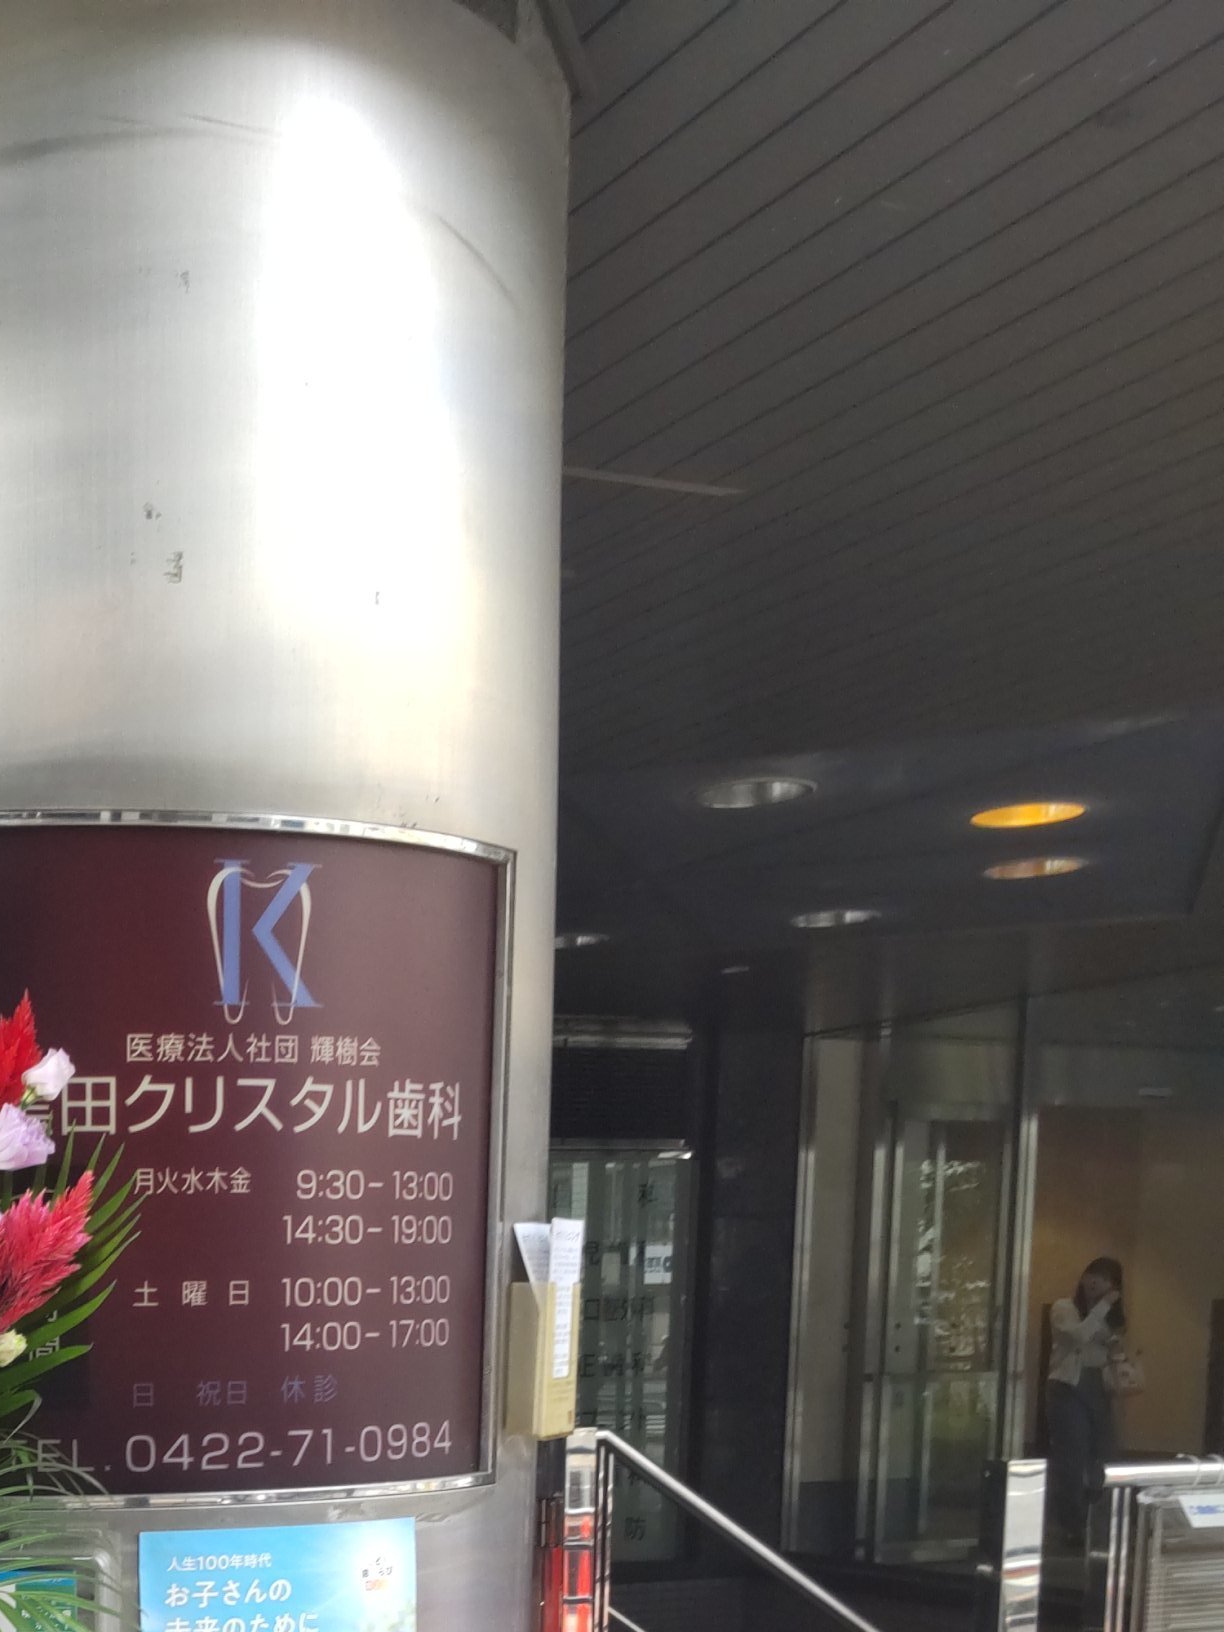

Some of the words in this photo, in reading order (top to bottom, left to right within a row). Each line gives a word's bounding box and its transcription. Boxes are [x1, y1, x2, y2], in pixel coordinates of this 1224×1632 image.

[125, 1032, 299, 1065] 医療法人社団
[310, 1034, 382, 1067] 輝樹会
[25, 1073, 463, 1141] 田クリスタル歯科
[133, 1166, 252, 1196] 月火水木金
[125, 1420, 453, 1473] 0422-71-0984
[167, 1552, 272, 1572] 人生100年時代
[163, 1578, 292, 1609] お子さんの
